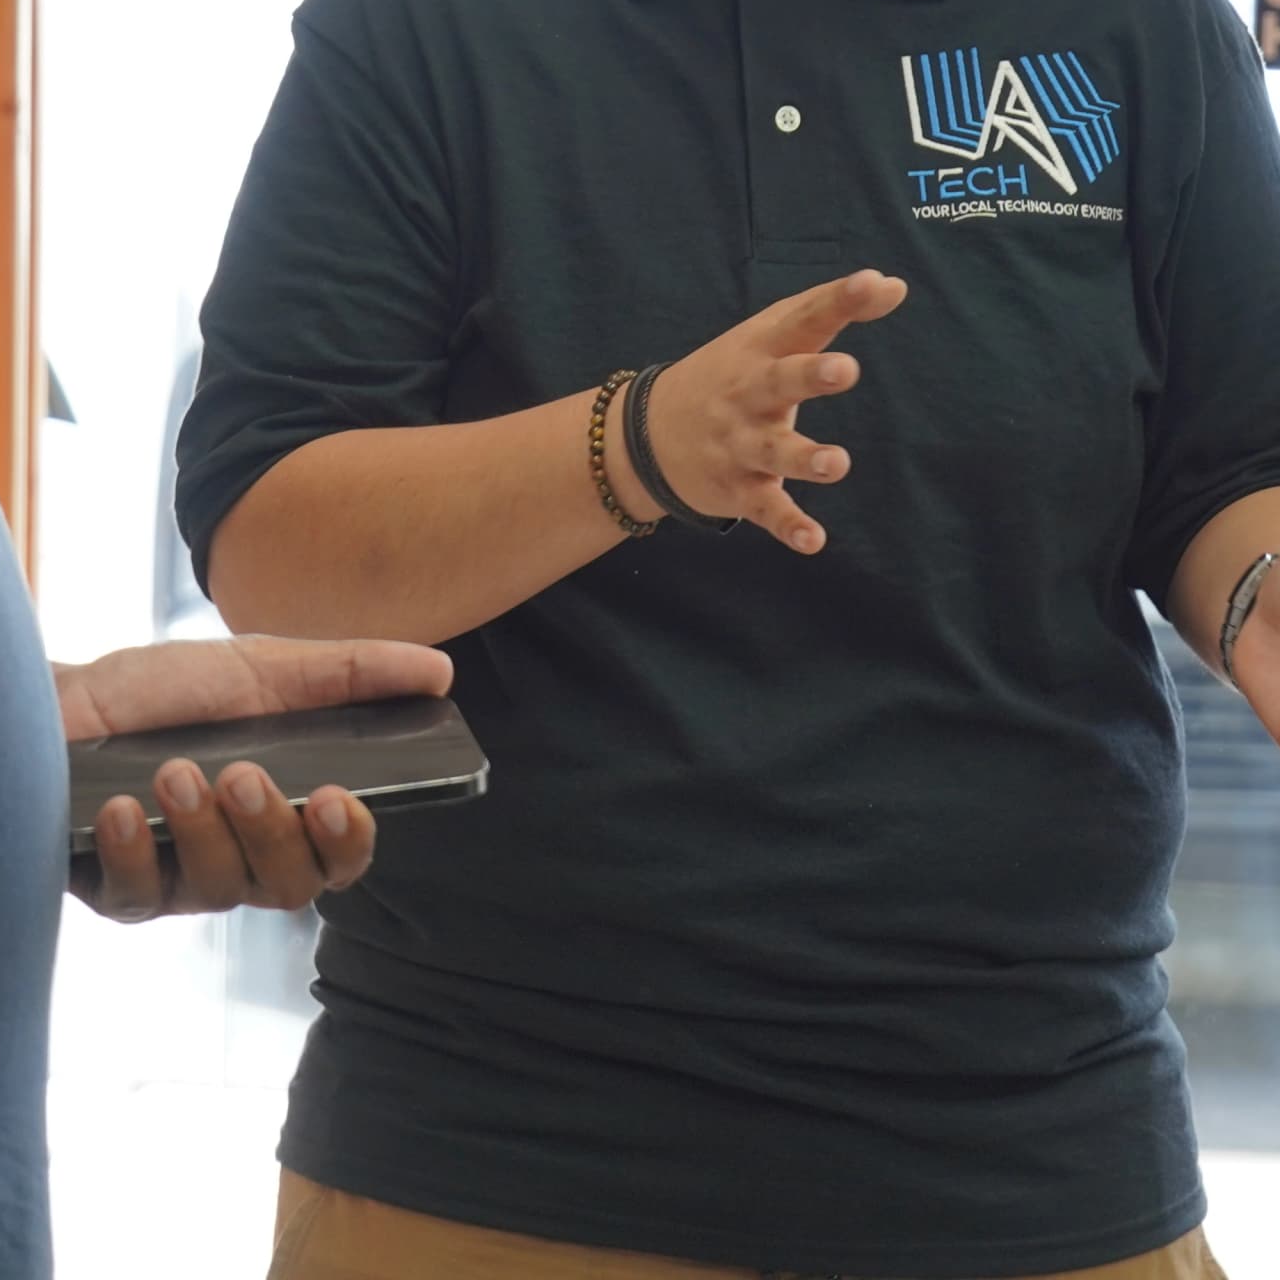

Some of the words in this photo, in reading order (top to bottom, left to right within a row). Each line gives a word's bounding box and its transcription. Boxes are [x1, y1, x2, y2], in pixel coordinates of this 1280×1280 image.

[907, 164, 1029, 202] TECH
[912, 205, 951, 220] YOUR
[951, 200, 996, 217] LOCAL
[997, 199, 1079, 217] TECHNOLOGY
[1081, 203, 1123, 221] EXPERTS
